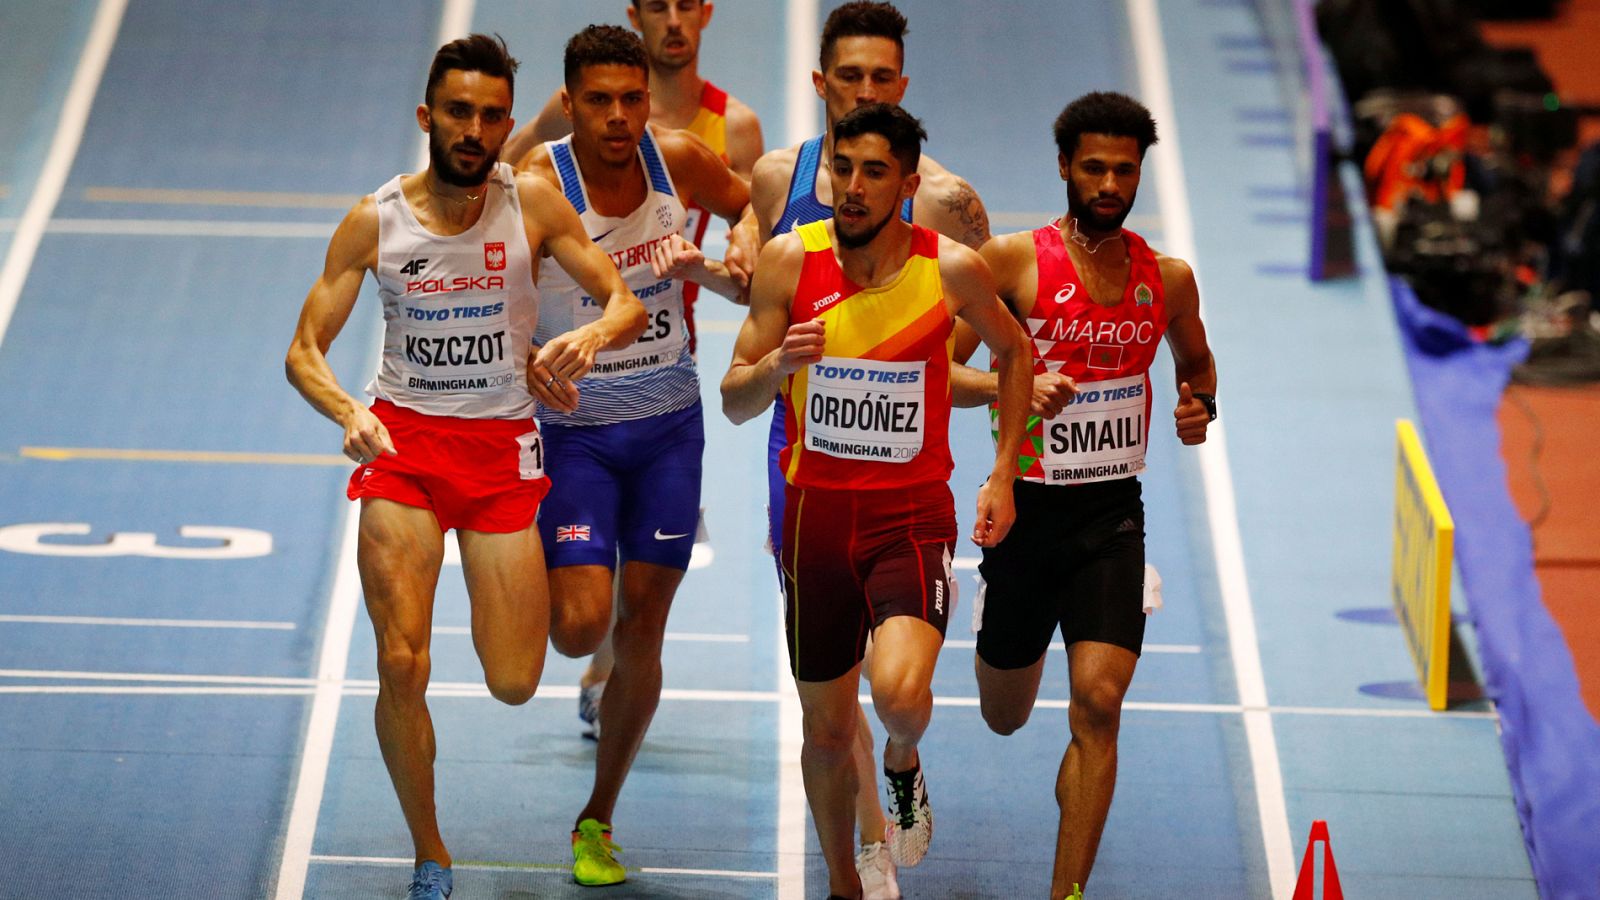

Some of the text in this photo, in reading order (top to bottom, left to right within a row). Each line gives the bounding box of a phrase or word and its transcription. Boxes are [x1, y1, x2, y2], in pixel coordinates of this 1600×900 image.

[400, 258, 429, 276] 4F
[406, 275, 504, 294] POLSKA
[406, 301, 505, 321] TOYO TIRES
[1051, 317, 1153, 345] MAROC
[405, 330, 505, 367] KSZCZOT
[590, 354, 660, 374] IRMINGHAM
[815, 364, 921, 384] TOYO TIRES
[408, 372, 513, 391] BIRMINGHAM 2018
[1102, 383, 1144, 402] TIRES
[811, 392, 919, 433] ORDÓÑEZ
[1050, 414, 1142, 455] SMAILI
[812, 436, 919, 459] BIRMINGHAM 2018
